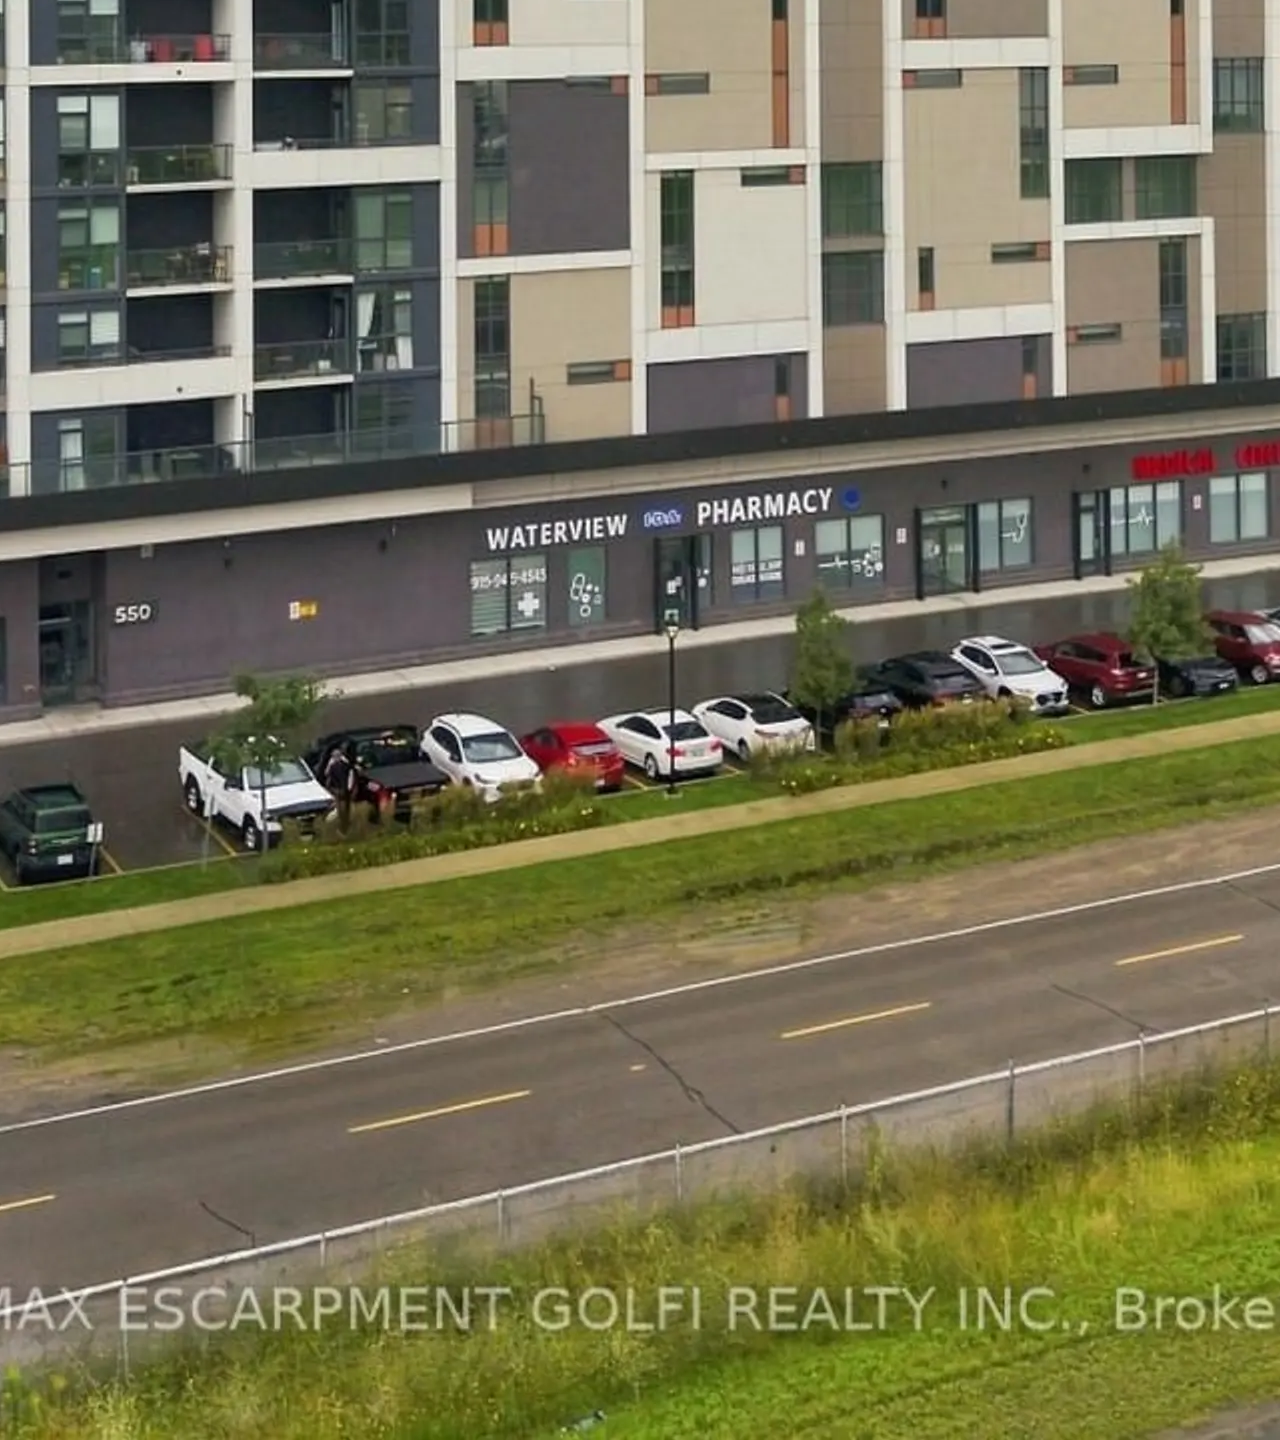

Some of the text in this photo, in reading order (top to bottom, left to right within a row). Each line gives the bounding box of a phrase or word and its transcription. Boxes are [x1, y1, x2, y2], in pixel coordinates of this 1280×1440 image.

[486, 514, 628, 550] WATERVIEW
[697, 487, 833, 526] PHARMACY
[115, 604, 152, 623] 550
